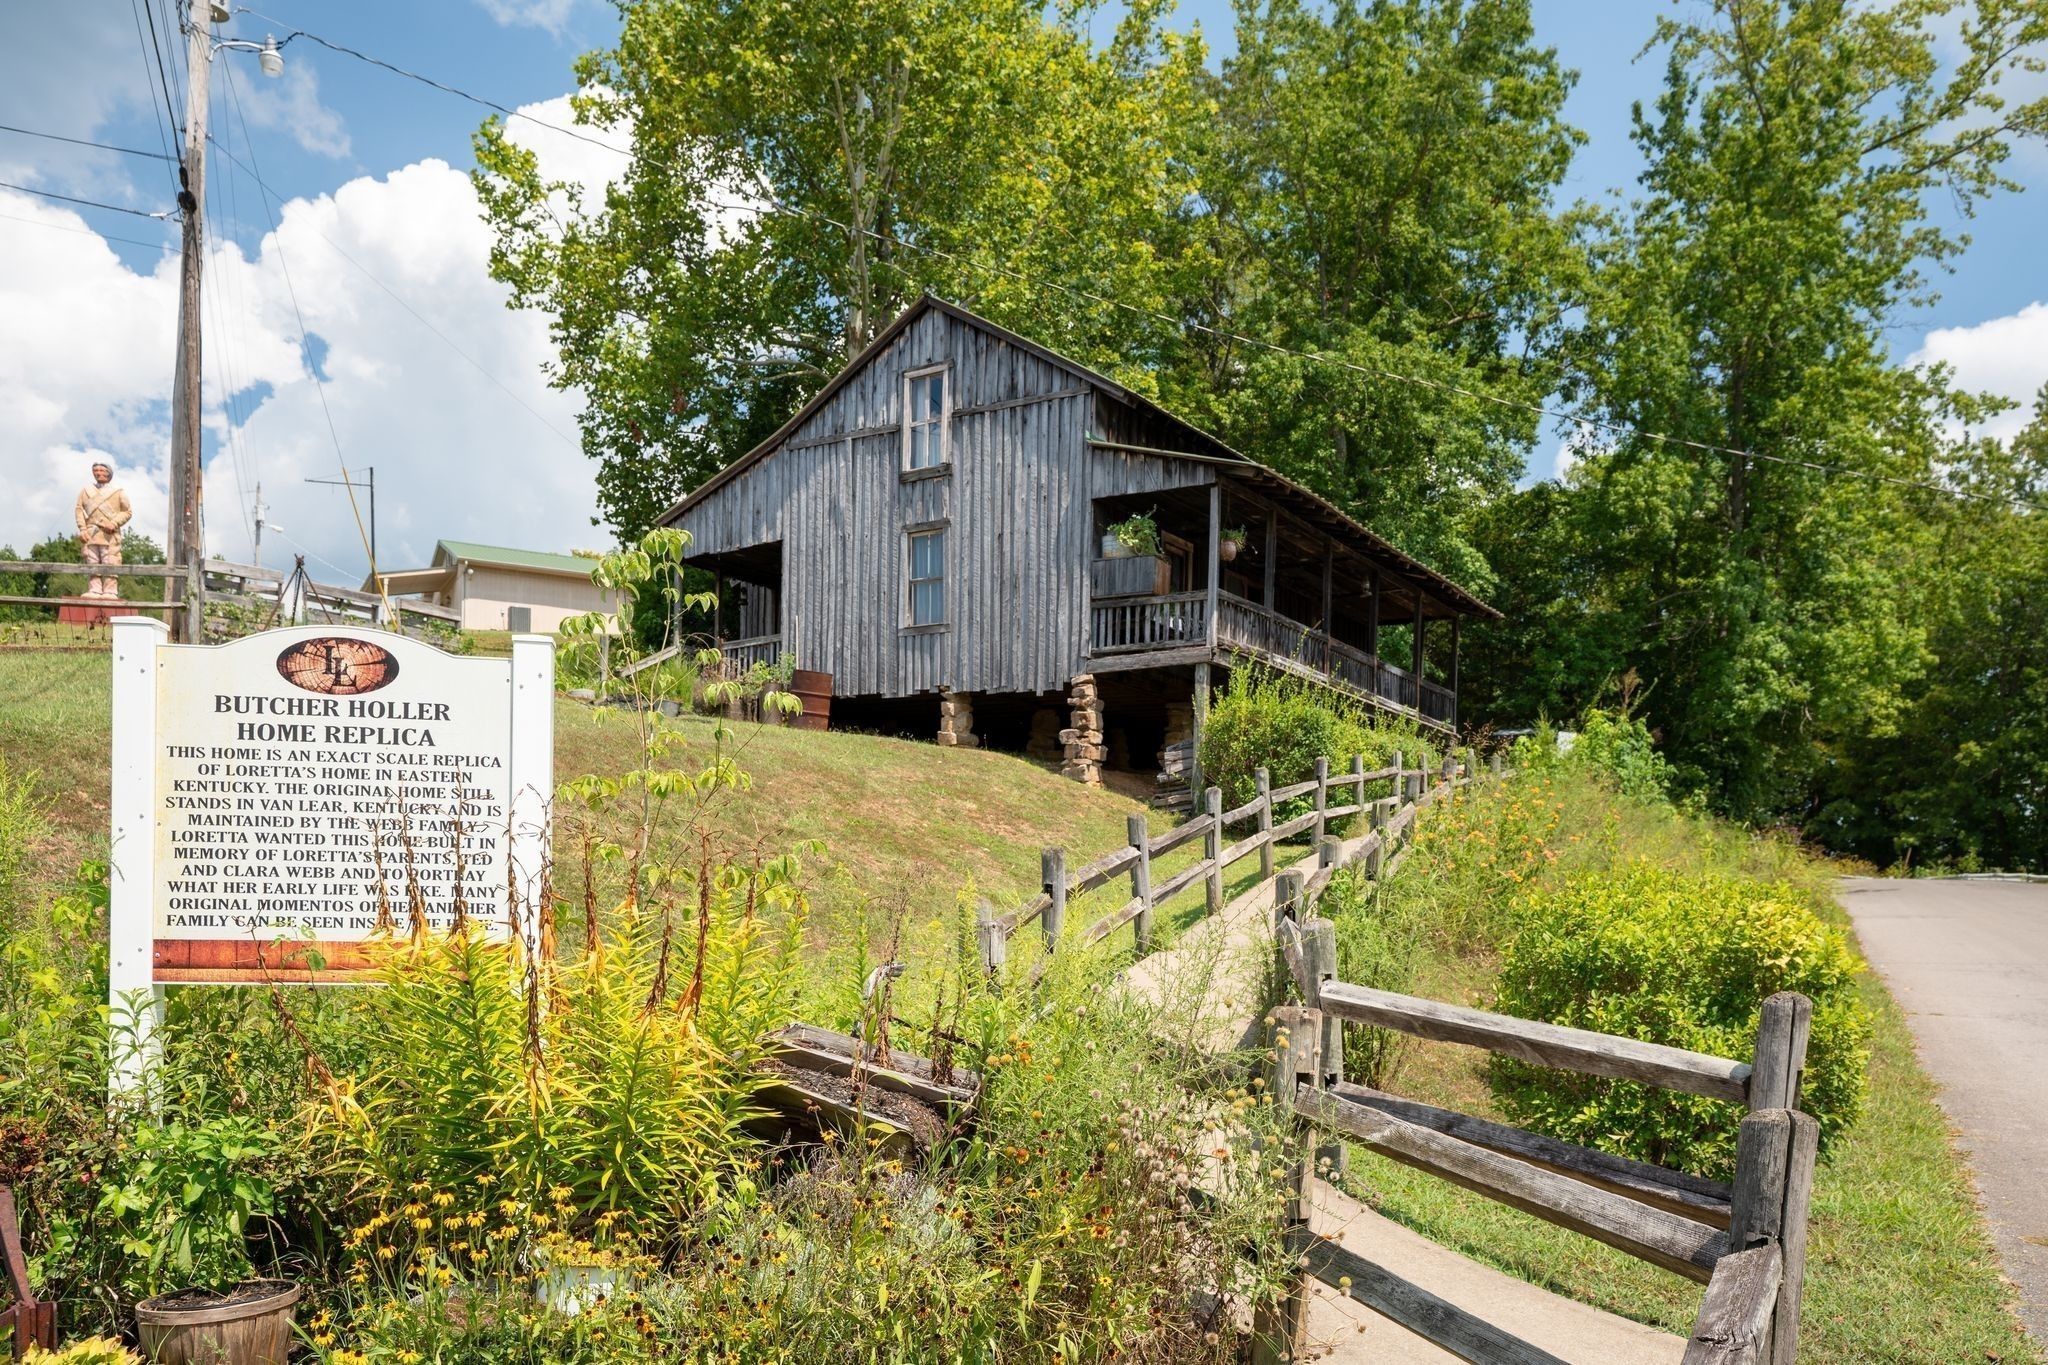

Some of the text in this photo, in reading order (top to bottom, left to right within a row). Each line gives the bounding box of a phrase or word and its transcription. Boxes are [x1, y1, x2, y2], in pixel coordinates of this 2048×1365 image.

[214, 695, 451, 721] BUTCHER HOLLER
[237, 722, 436, 747] HOME REPLICA
[166, 745, 502, 768] THIS HOME IS AN EXACT SCALE REPLICA
[197, 763, 473, 783] OF LORETTA'S HOME IN EASTERN
[173, 780, 495, 801] KENTUCKY. THE ORIGINAL HOME STILL
[165, 797, 502, 817] STANDS IN VAN LEAR, KENTUCKY AND IS
[188, 814, 294, 828] MAINTAINED
[300, 816, 322, 829] BY
[327, 817, 360, 829] THE
[366, 818, 414, 831] WEBB
[171, 830, 249, 843] LORETTA
[254, 832, 326, 845] WANTED
[331, 833, 369, 846] THIS
[479, 837, 496, 850] IN
[174, 847, 492, 866] MEMORY OF LORETTA'S PARENTS, TED
[181, 864, 217, 876] AND
[223, 865, 280, 877] CLARA
[286, 866, 335, 878] WEBB
[341, 867, 376, 880] AND
[382, 868, 403, 880] TO
[167, 881, 218, 893] WHAT
[224, 881, 257, 894] HER
[263, 882, 317, 895] EARLY
[323, 884, 358, 896] LIFE
[405, 885, 445, 898] LKE.
[169, 897, 252, 910] ORIGINAL
[257, 898, 354, 912] MOMENTOS
[166, 914, 230, 927] FAMILY
[235, 915, 270, 928] CAN
[275, 916, 297, 928] BE
[302, 916, 344, 929] SEEN
[349, 917, 404, 929] INSE
